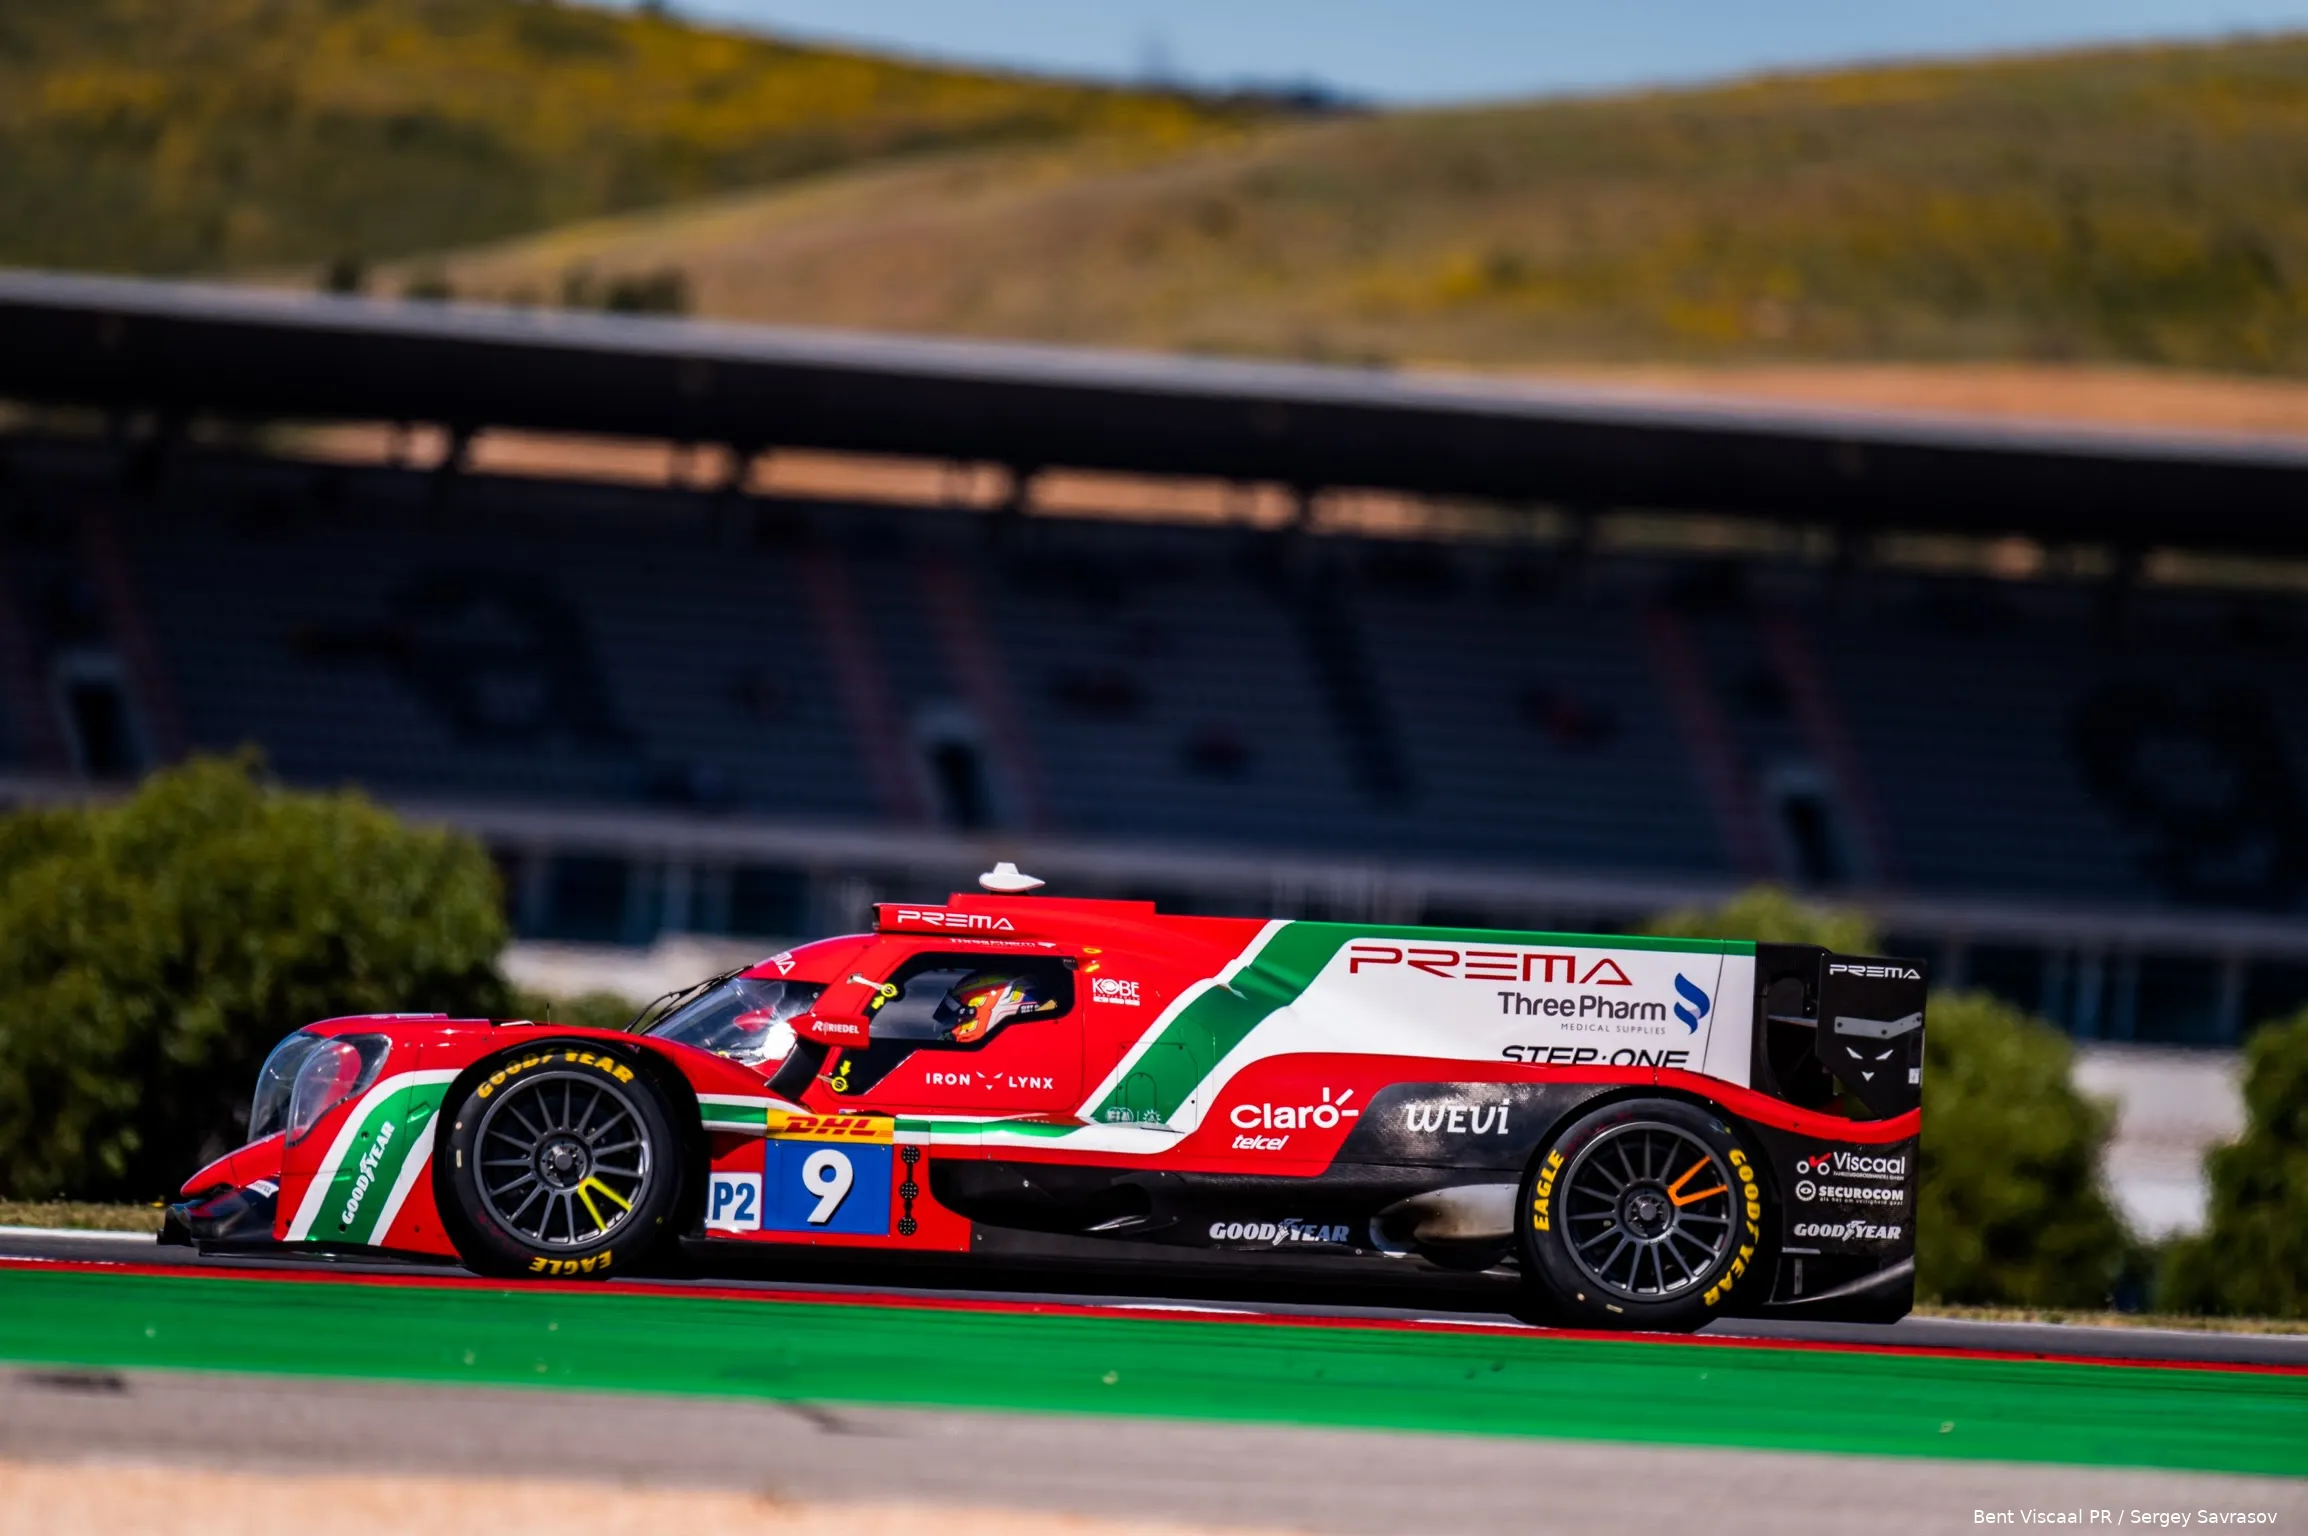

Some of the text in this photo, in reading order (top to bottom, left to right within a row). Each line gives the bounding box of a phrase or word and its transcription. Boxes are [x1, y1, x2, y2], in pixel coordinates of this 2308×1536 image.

[897, 909, 1015, 931] PREMA
[1349, 945, 1633, 986] PREMA
[1829, 964, 1921, 979] PREMA
[1092, 977, 1140, 998] KOBE
[1561, 1022, 1667, 1035] MEDICAL SUPPLIES
[925, 1073, 1054, 1089] IRON LYNX
[783, 1116, 876, 1136] DHL
[1230, 1104, 1340, 1129] Claro
[1231, 1134, 1290, 1151] telcel
[342, 1121, 395, 1225] GOODYEAR
[1833, 1152, 1905, 1174] Viscaal
[802, 1149, 853, 1226] 9
[1534, 1149, 1565, 1231] EAGLE
[1818, 1186, 1904, 1201] SECUROCOM
[712, 1182, 756, 1221] P2
[1209, 1218, 1350, 1246] GOODYEAR
[1703, 1149, 1760, 1306] GOODYEAR
[1794, 1221, 1902, 1241] GOODYEAR
[530, 1249, 612, 1275] EAGLE
